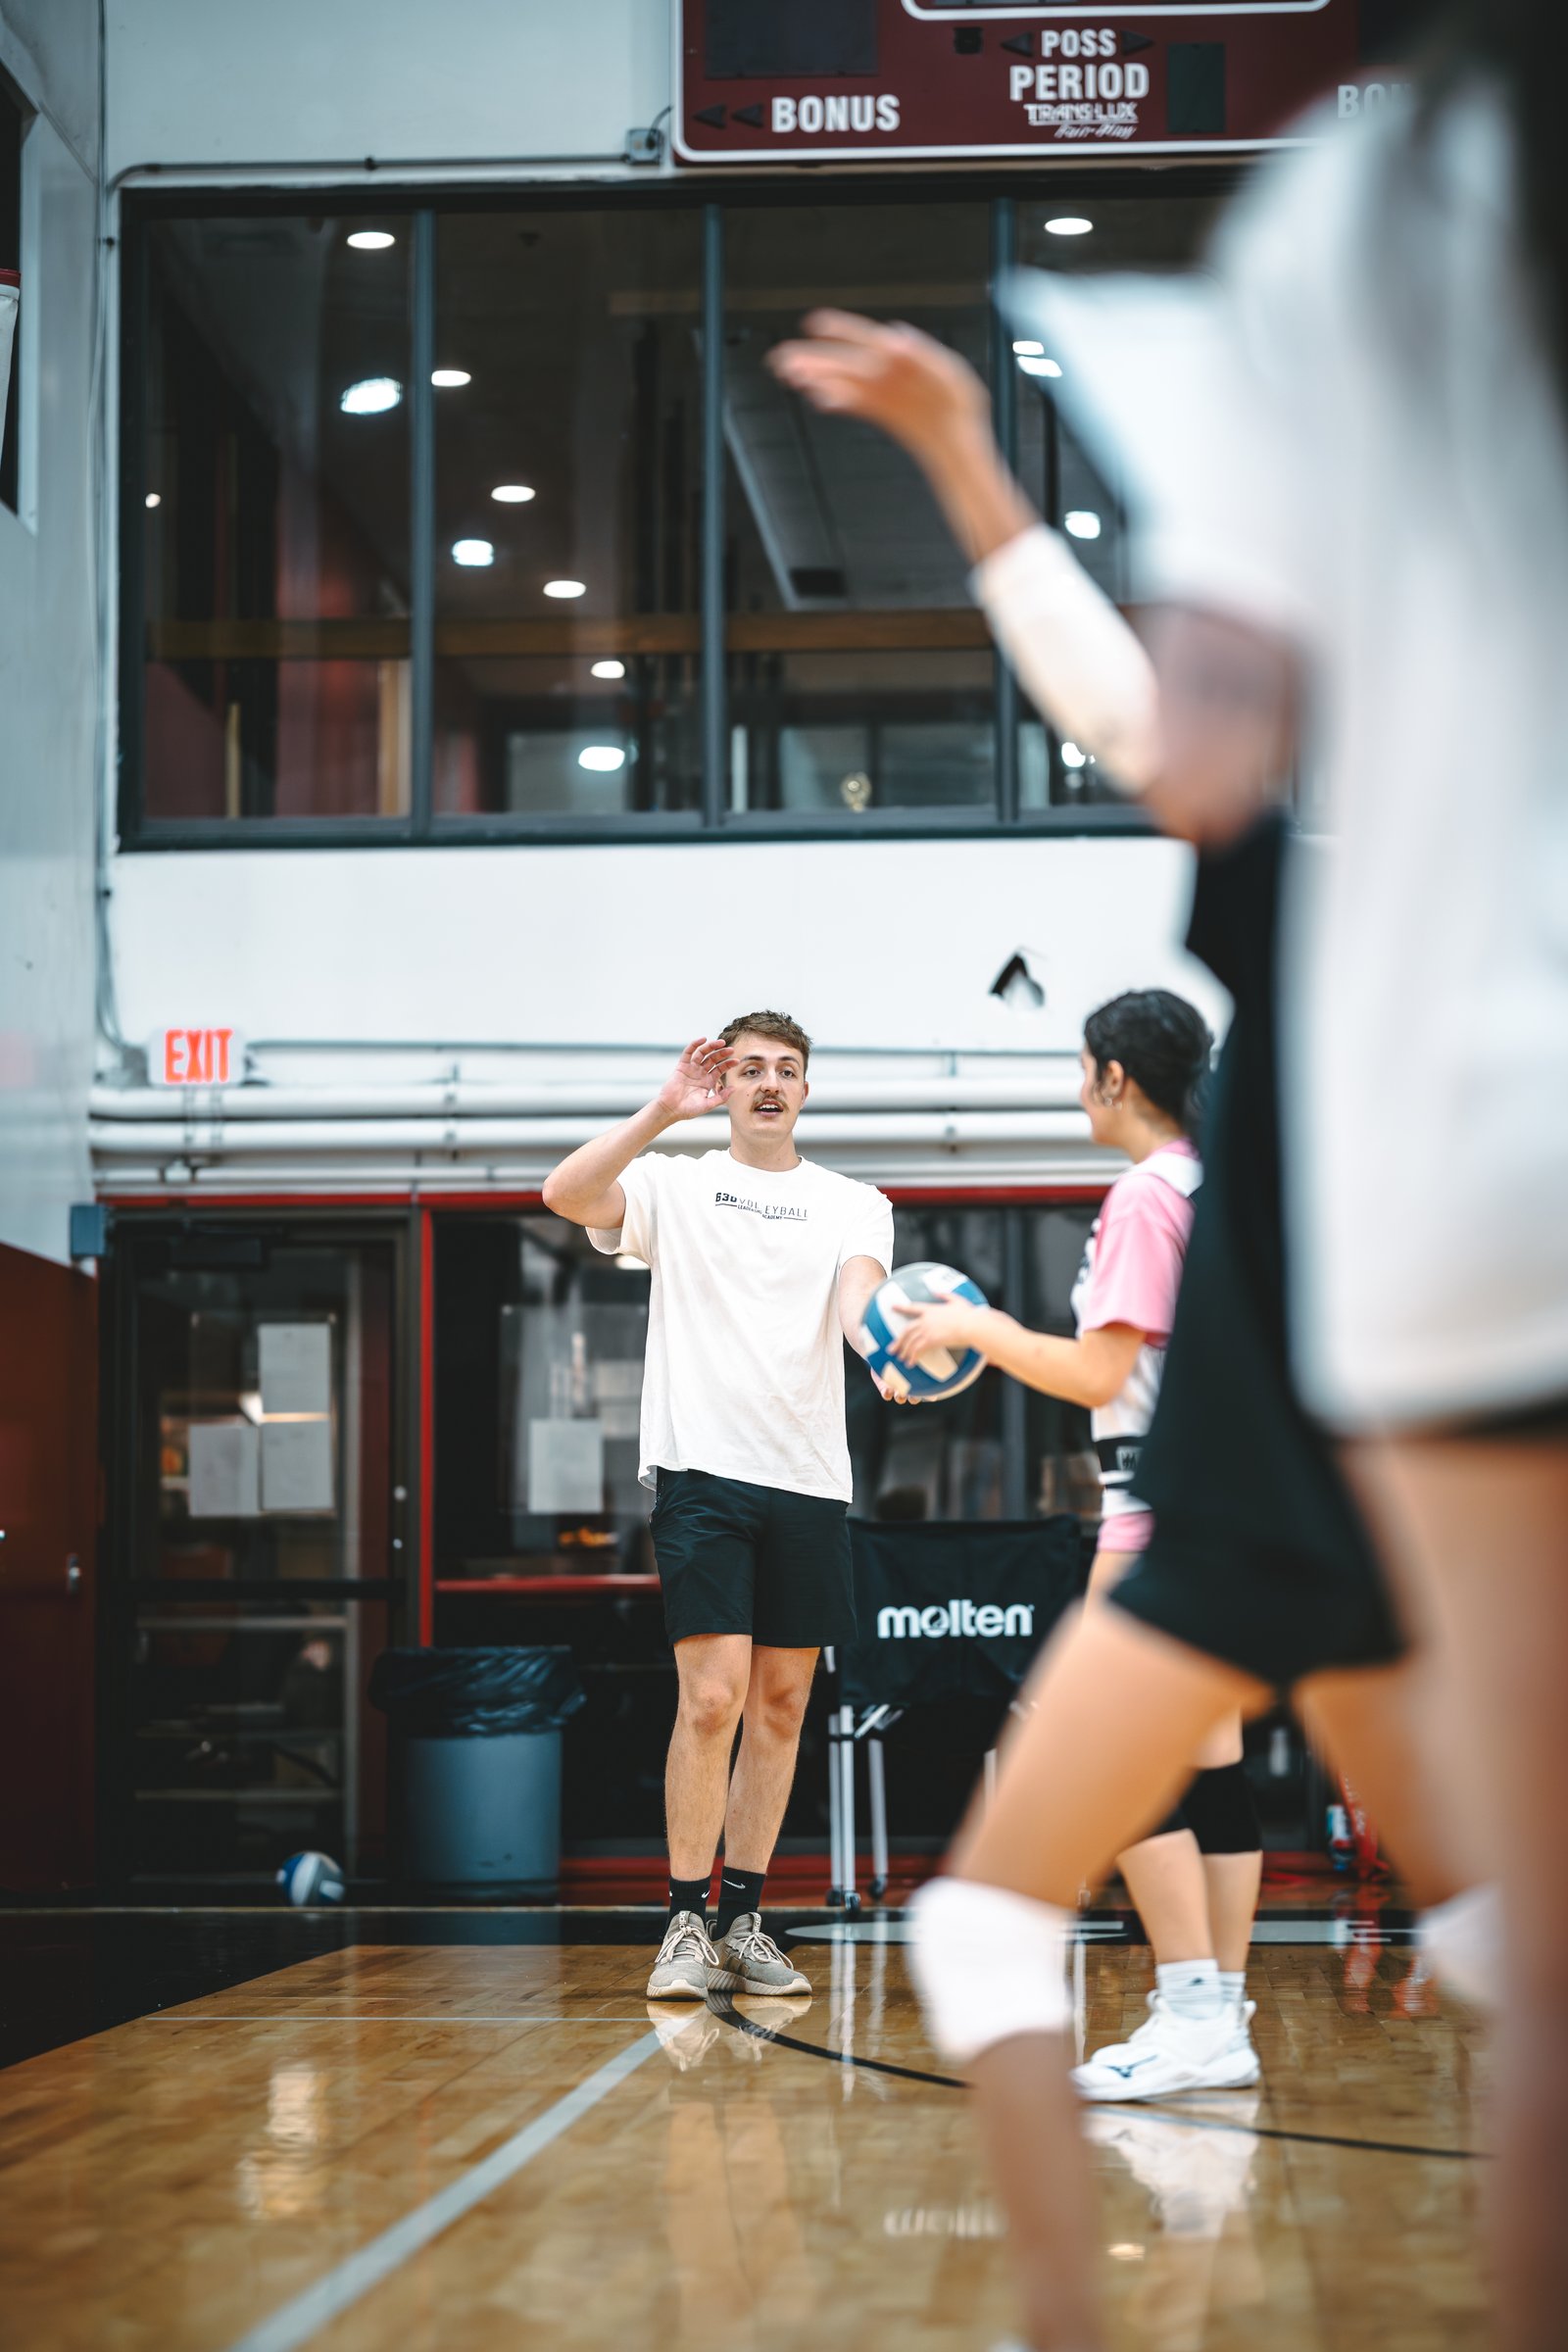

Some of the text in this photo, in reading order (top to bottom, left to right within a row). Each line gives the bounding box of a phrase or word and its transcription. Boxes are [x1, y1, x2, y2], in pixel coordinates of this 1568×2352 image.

[1041, 28, 1117, 58] POSS
[1009, 63, 1150, 101] PERIOD
[771, 94, 901, 133] BONUS
[165, 1028, 233, 1083] EXIT
[877, 1599, 1033, 1639] molten
